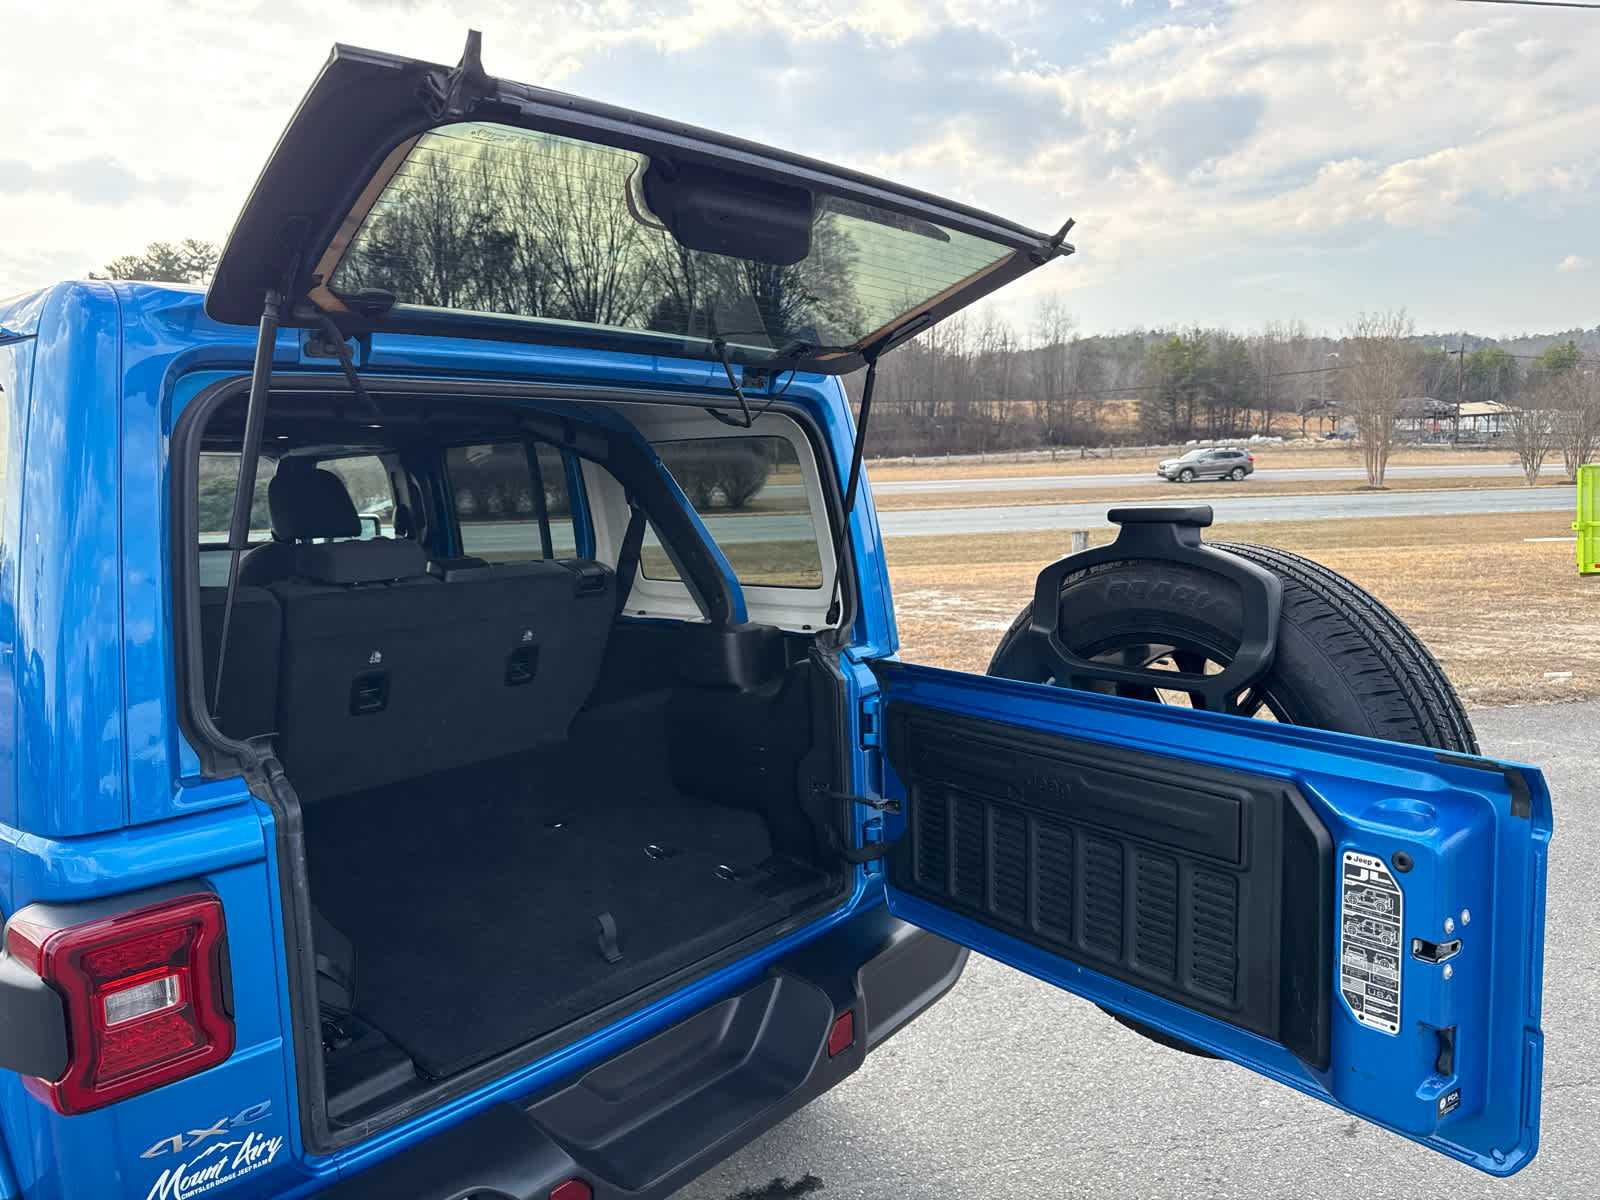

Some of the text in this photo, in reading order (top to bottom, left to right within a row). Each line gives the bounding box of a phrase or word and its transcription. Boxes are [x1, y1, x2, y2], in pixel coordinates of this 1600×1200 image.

[1353, 855, 1373, 866] Jeep
[1345, 868, 1393, 885] JL
[1367, 987, 1394, 1002] USA
[146, 1131, 284, 1200] Mount Airy
[181, 1158, 269, 1200] CHRYSLER DODGE JEEP RAM
